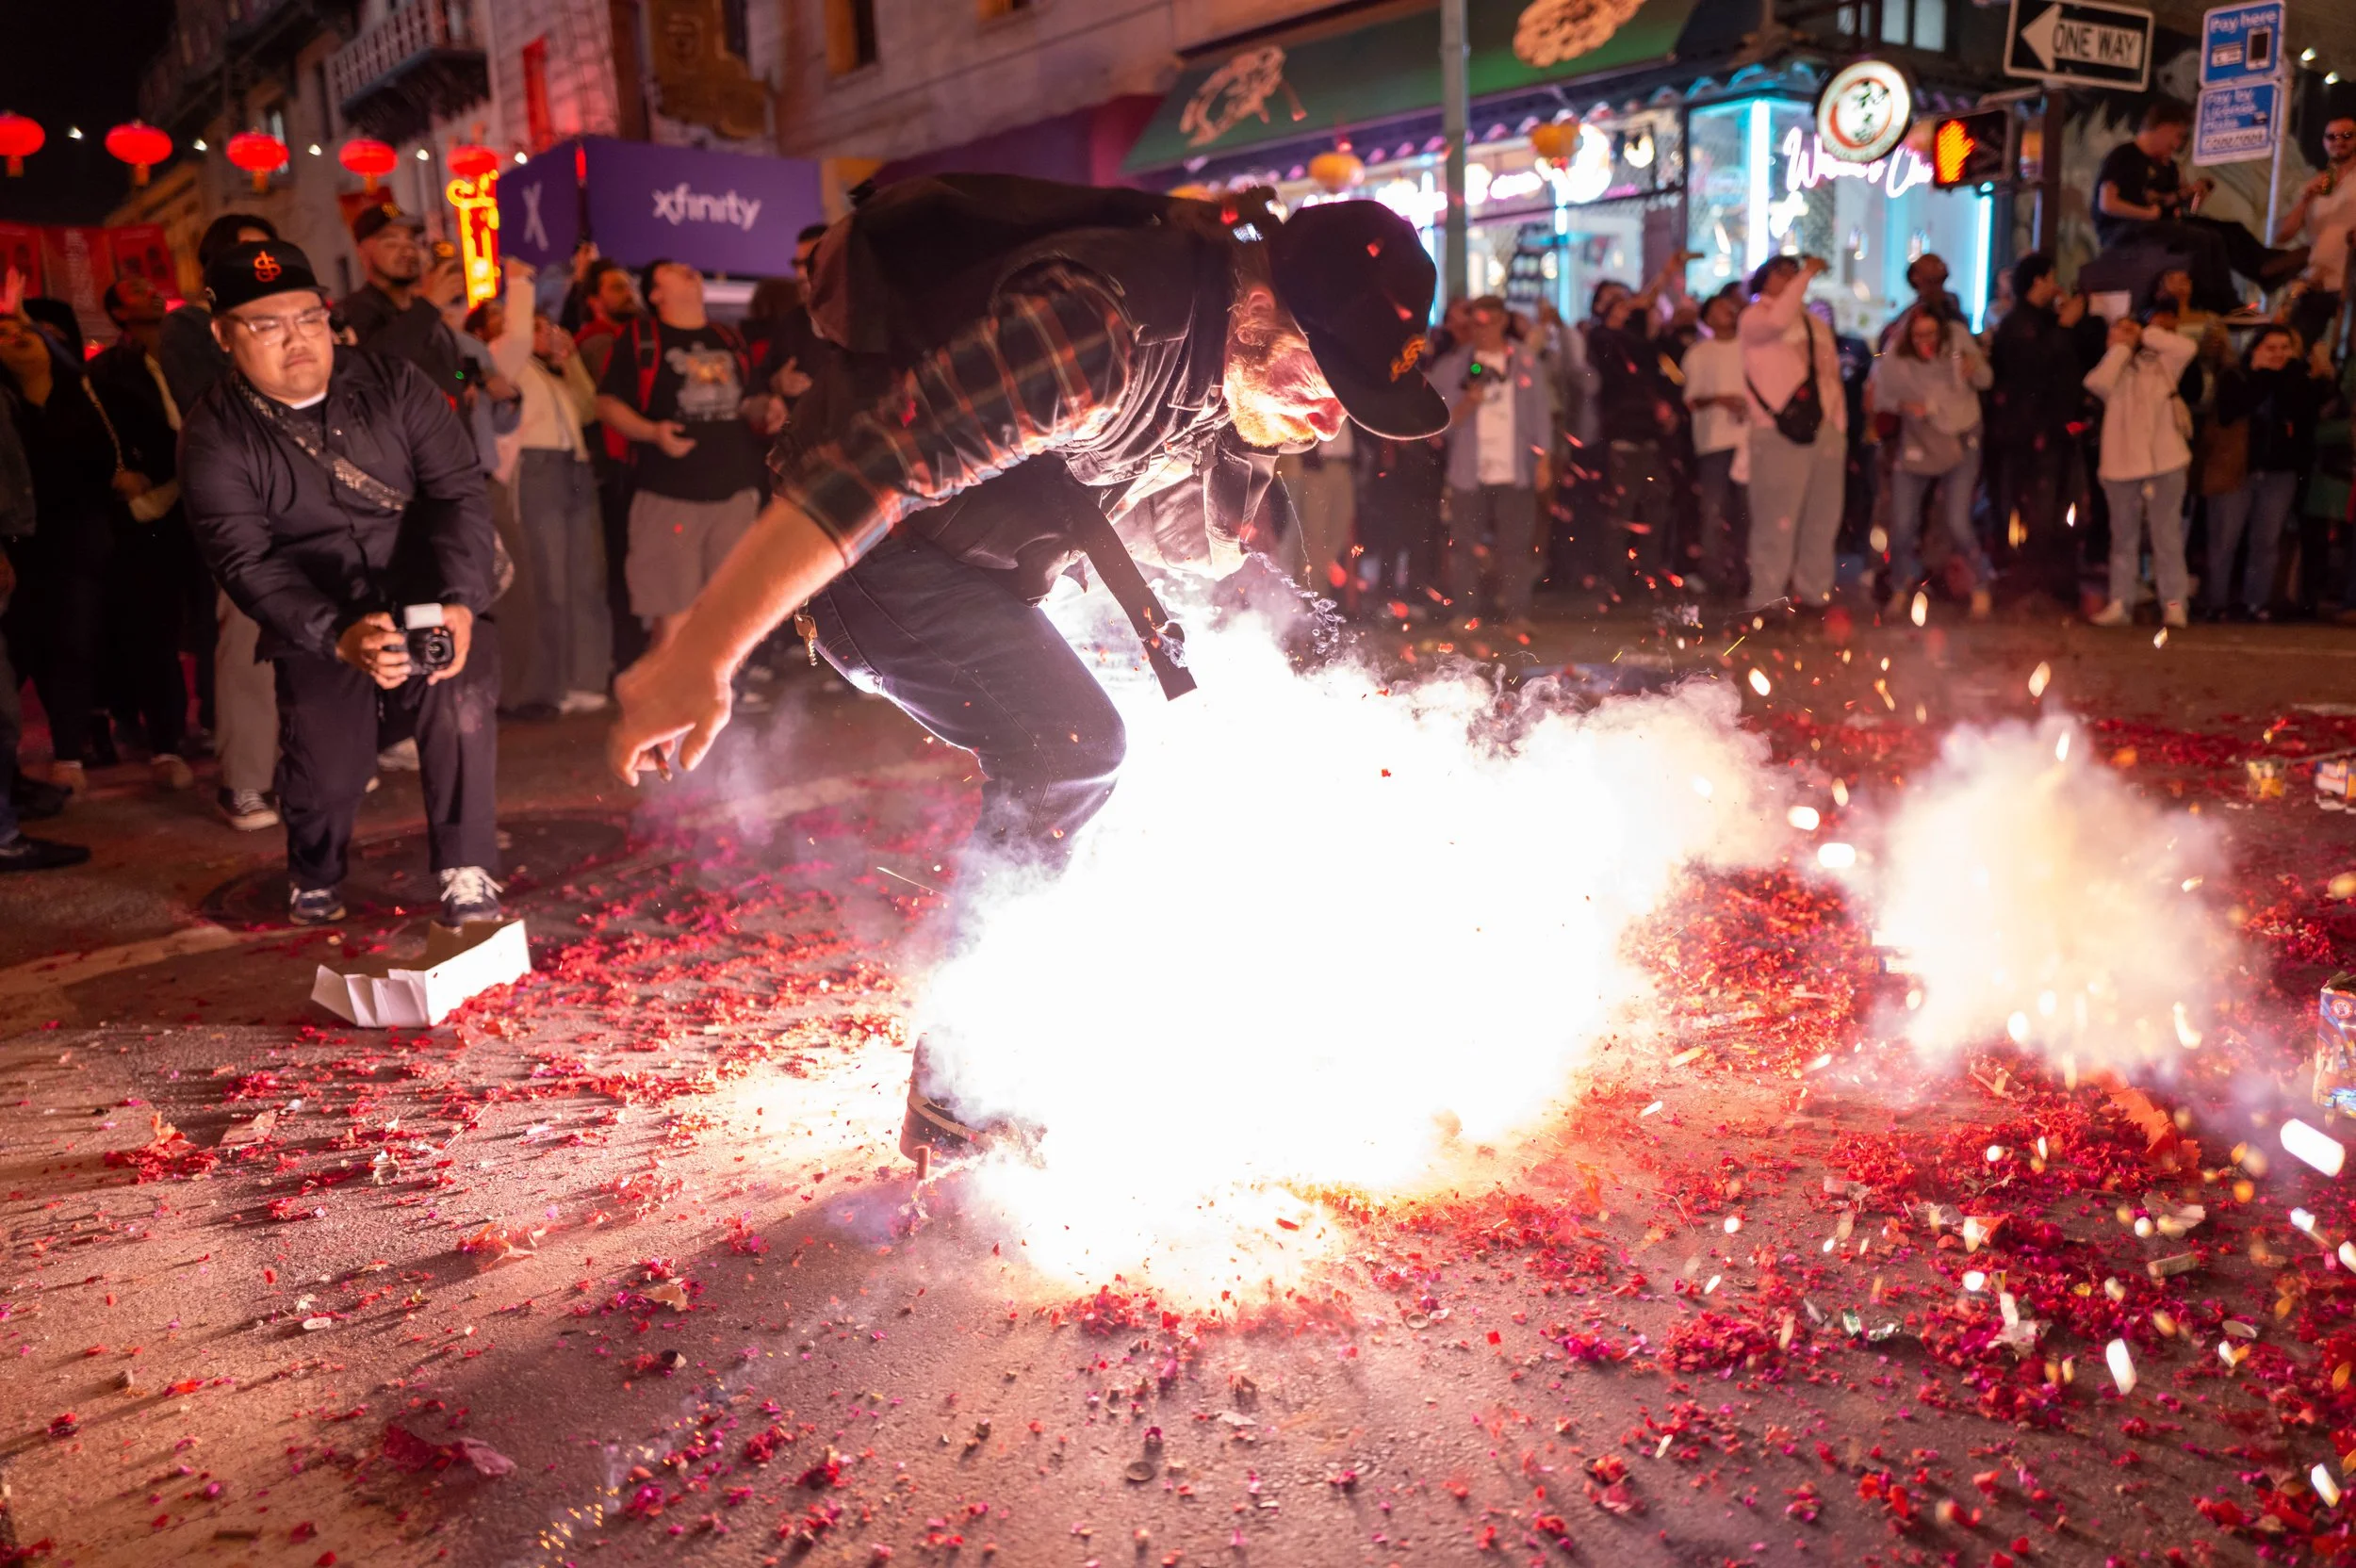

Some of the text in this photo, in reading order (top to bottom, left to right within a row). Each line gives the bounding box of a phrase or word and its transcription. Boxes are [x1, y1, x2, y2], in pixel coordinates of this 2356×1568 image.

[2209, 10, 2278, 34] Pay here
[2053, 23, 2135, 63] ONE WAY
[652, 182, 761, 232] xfinity
